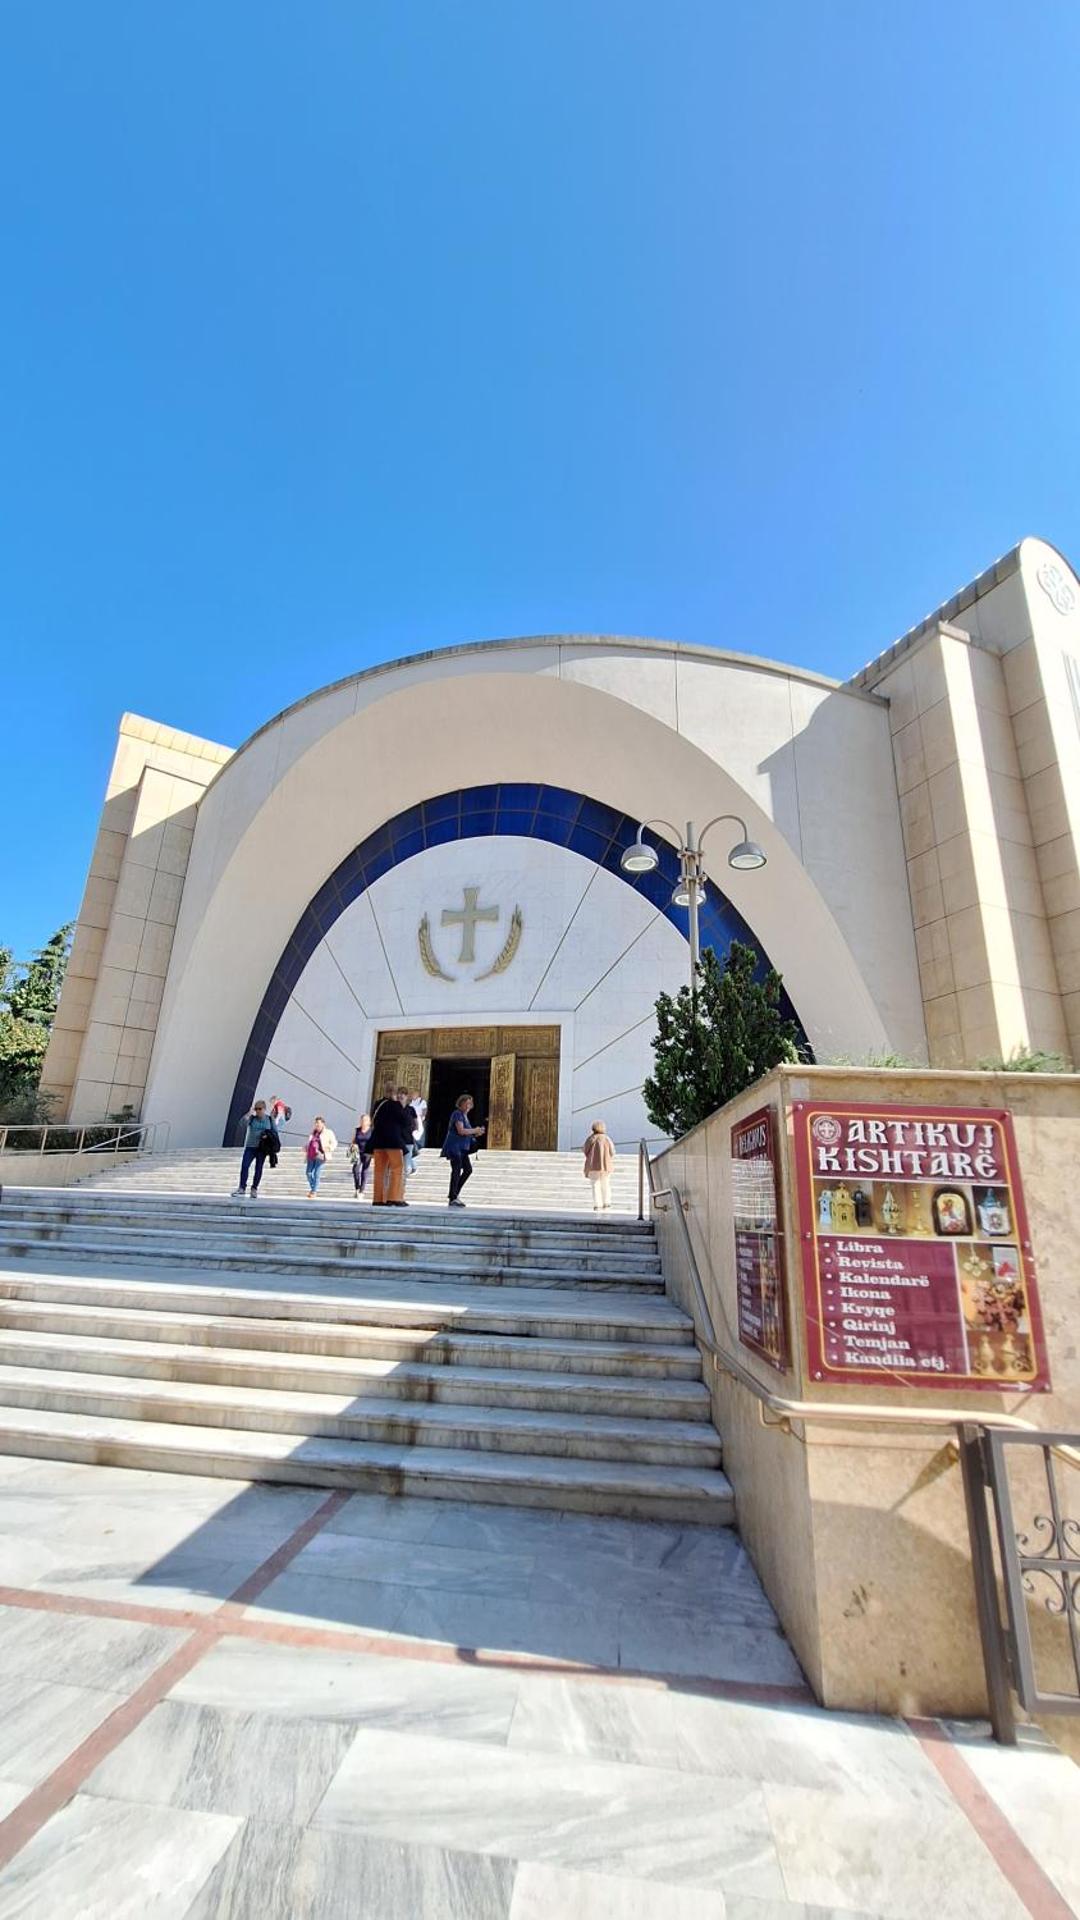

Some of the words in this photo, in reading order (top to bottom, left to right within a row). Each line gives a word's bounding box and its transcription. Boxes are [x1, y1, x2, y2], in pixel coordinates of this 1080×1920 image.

[848, 1119, 994, 1148] ARTIKUJ
[817, 1146, 998, 1178] KISHTARË
[836, 1241, 884, 1253] Libra
[838, 1256, 904, 1270] Revista
[839, 1271, 930, 1287] Kalendarë
[840, 1286, 892, 1300] Ikona
[841, 1302, 895, 1318] Kryqe
[842, 1319, 896, 1335] Qirinj
[843, 1335, 911, 1351] Temjan
[844, 1351, 917, 1367] Kandila
[921, 1356, 951, 1371] etj.
